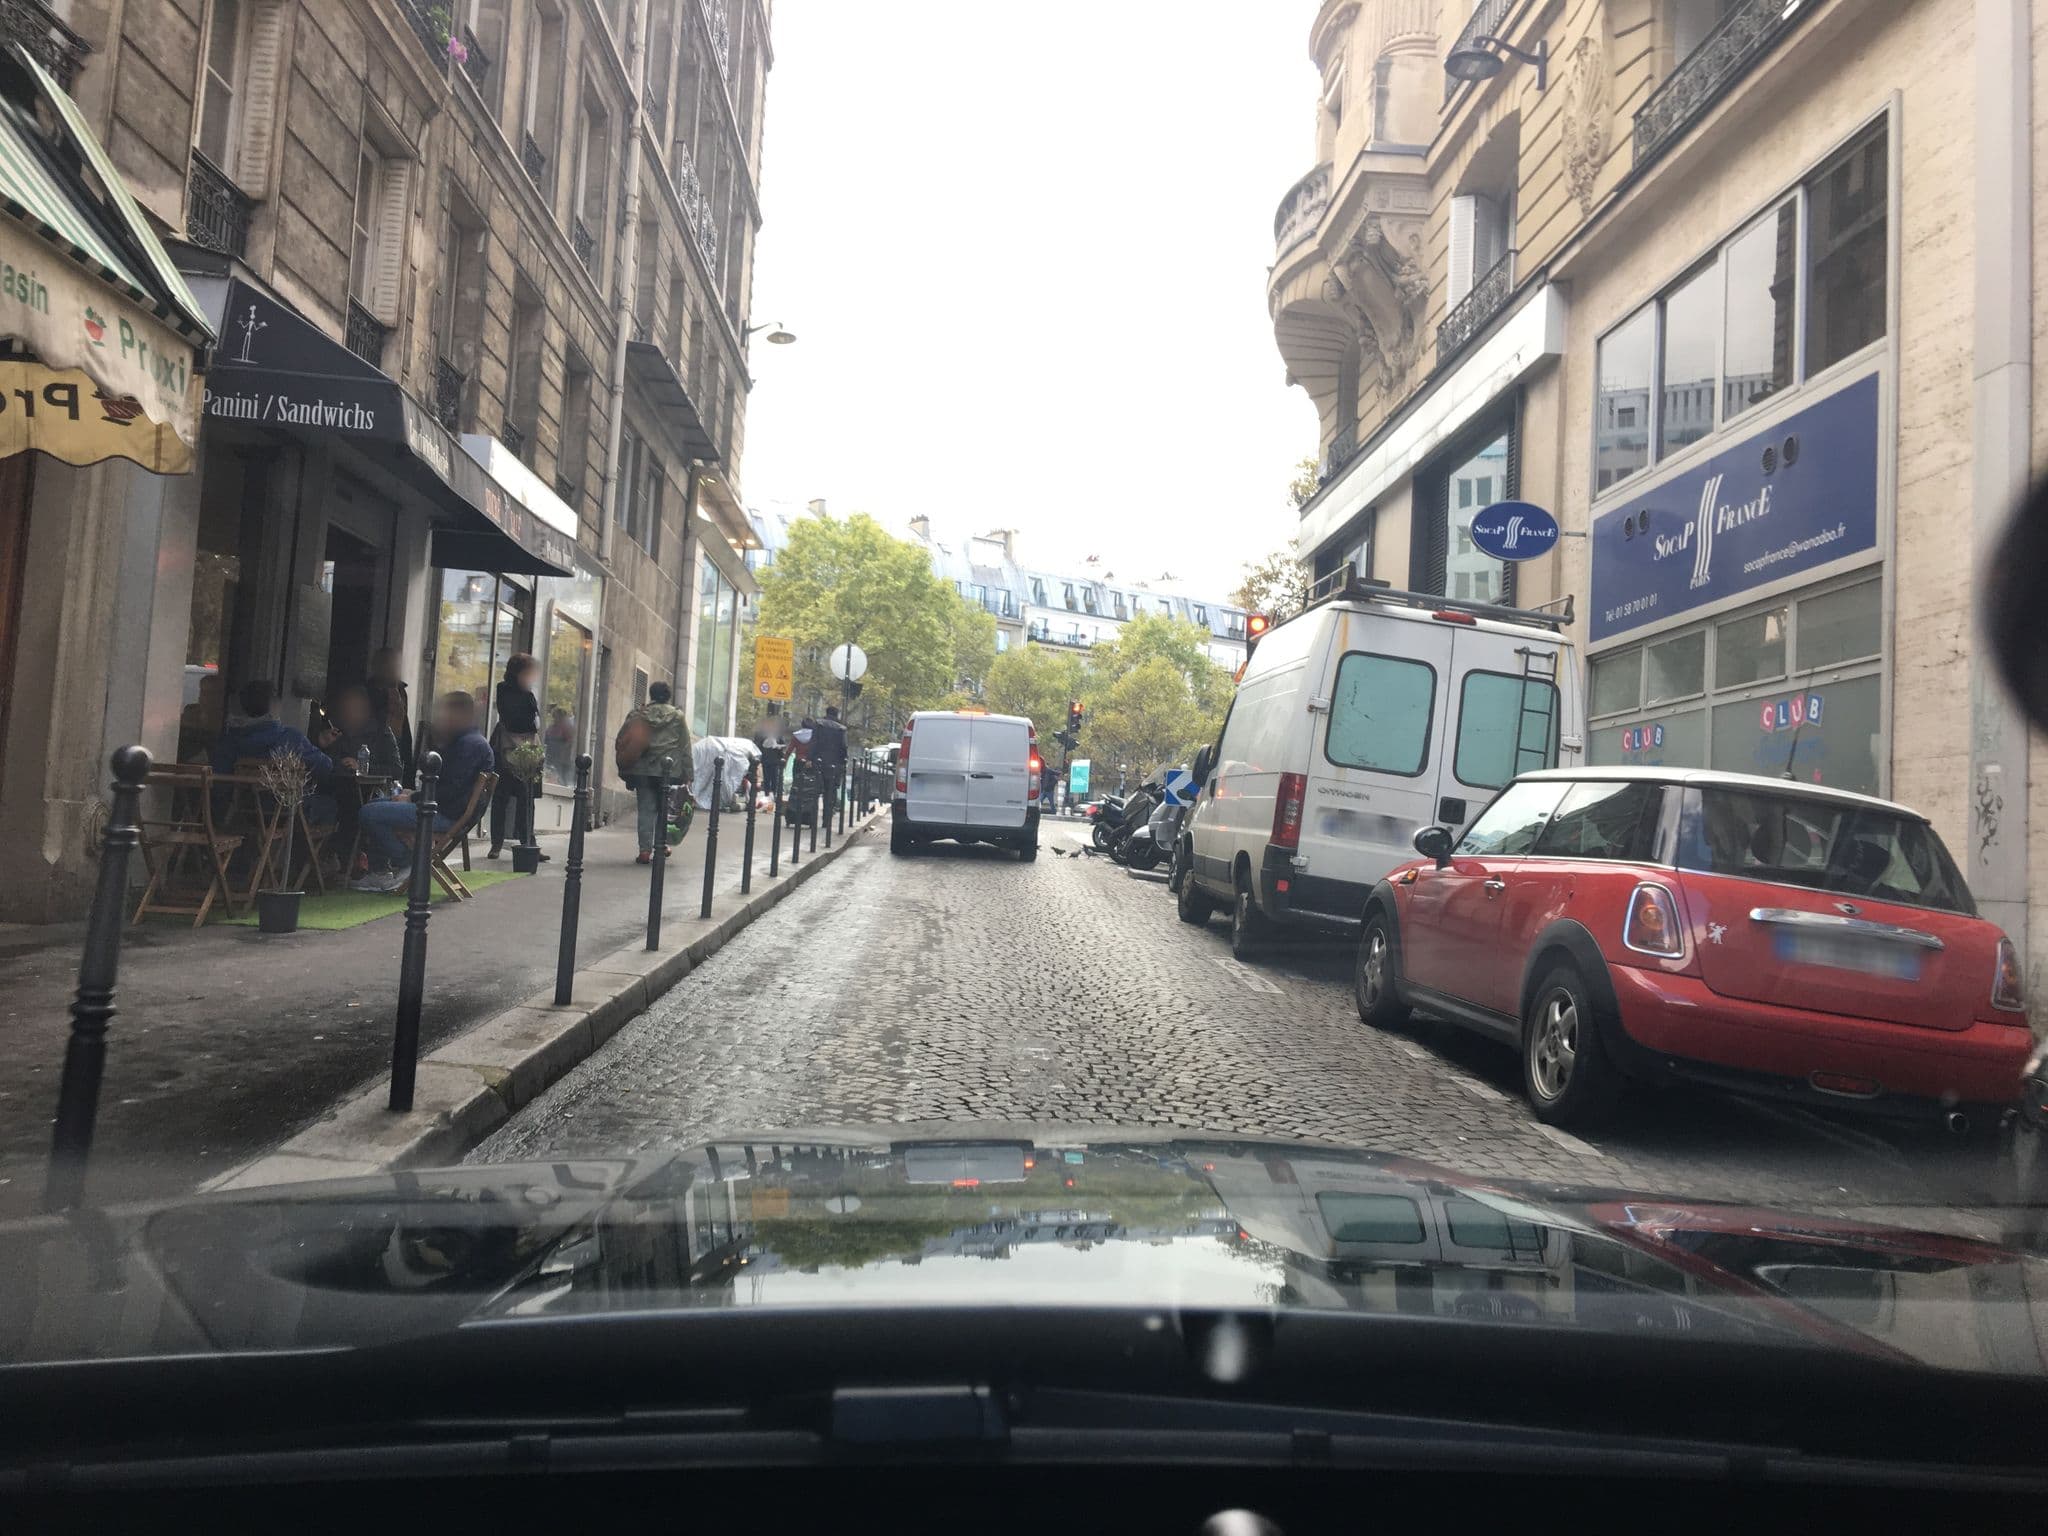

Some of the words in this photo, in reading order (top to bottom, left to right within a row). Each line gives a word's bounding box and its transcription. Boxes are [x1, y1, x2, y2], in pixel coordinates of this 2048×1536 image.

[118, 315, 186, 397] Proxi
[201, 388, 259, 420] Panini
[277, 395, 374, 430] Sandwichs
[1473, 524, 1505, 535] SOCAP
[1520, 526, 1556, 538] FRANCE
[1653, 520, 1695, 561] SOCAP
[1716, 484, 1773, 535] FRANCE
[1763, 698, 1820, 726] CLUB
[1623, 727, 1662, 749] CLUB
